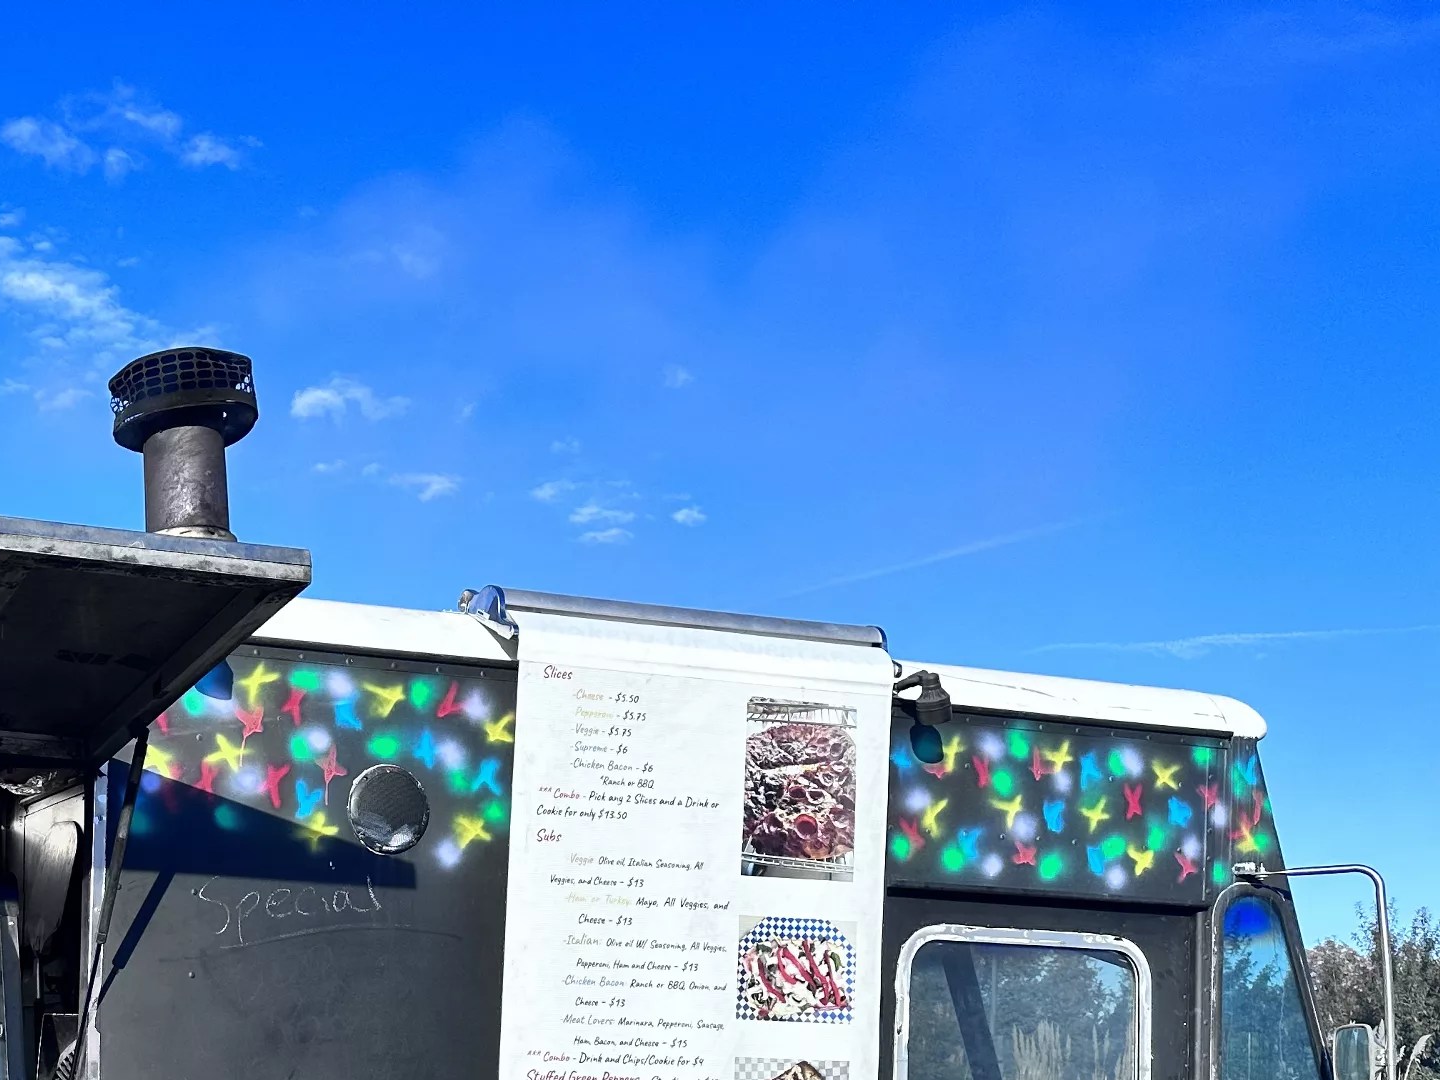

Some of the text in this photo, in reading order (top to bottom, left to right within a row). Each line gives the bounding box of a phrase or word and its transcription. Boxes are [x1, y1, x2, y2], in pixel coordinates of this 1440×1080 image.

[544, 665, 572, 679] Slices
[615, 693, 639, 703] $5.50
[608, 760, 632, 771] Bacon
[554, 788, 579, 799] Combo
[589, 791, 605, 801] Pick
[609, 796, 623, 805] any
[659, 797, 676, 805] and
[685, 797, 708, 808] Drink
[537, 805, 627, 821] Cookie for only $13.50
[537, 829, 562, 842] Subs
[627, 858, 652, 867] Italian
[594, 876, 617, 886] Cheese
[664, 897, 729, 909] All and
[199, 875, 383, 946] Special
[579, 914, 632, 926] Cheese $13
[613, 960, 629, 969] Ham
[647, 961, 671, 970] Cheese
[682, 961, 698, 972] $13
[630, 979, 652, 988] Ranch
[575, 997, 625, 1008] Cheese $13
[635, 1038, 659, 1047] Cheese
[544, 1052, 690, 1066] Combo Drink and for
